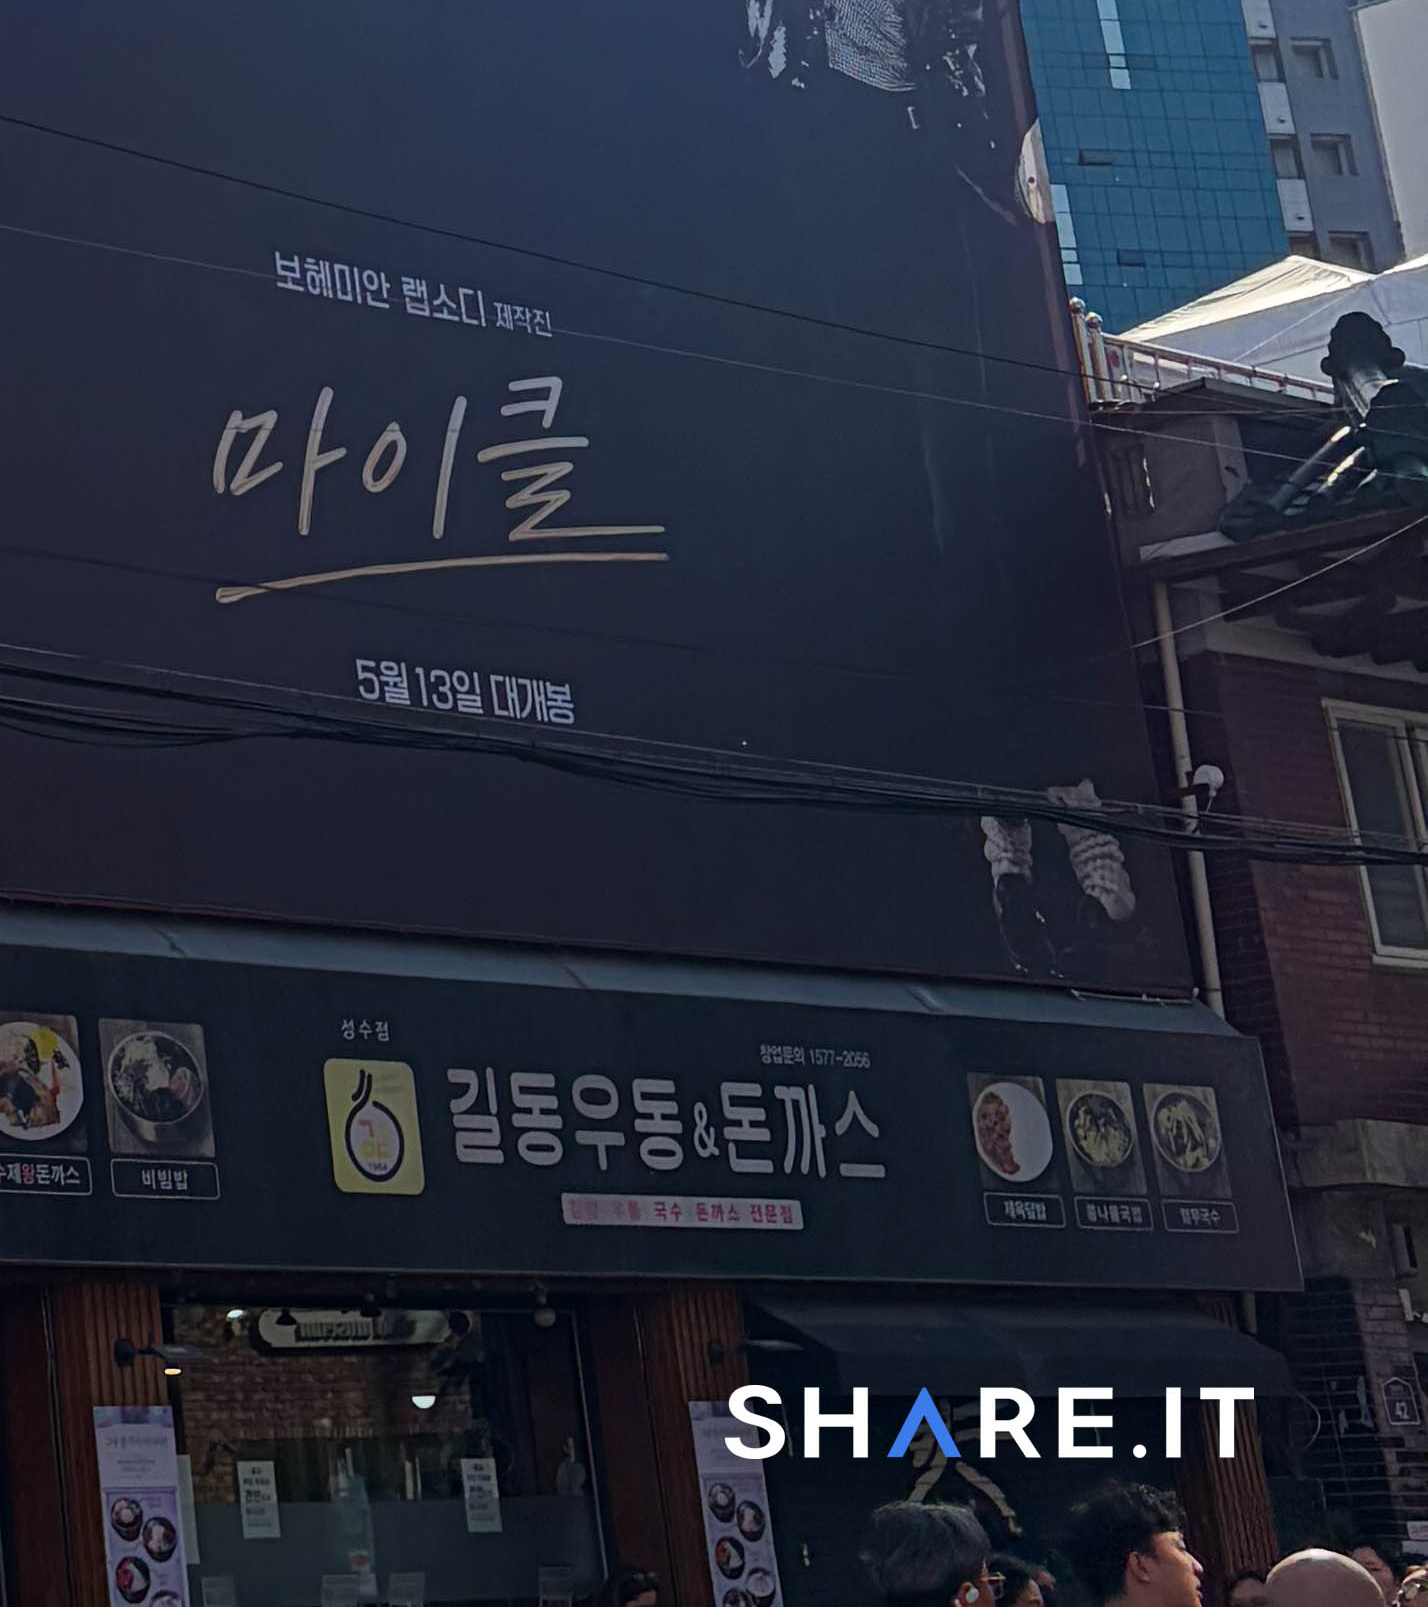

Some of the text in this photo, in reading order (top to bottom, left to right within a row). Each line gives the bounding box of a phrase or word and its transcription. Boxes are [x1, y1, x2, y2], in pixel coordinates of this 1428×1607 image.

[273, 250, 554, 338] 보헤미안 랩소디 제작진
[212, 375, 667, 543] 마이클
[355, 657, 577, 725] 5월 13일 대개봉
[339, 1017, 393, 1043] 성수점
[809, 1046, 873, 1070] 1577-2056
[445, 1066, 887, 1179] 길동우동&돈까스
[141, 1168, 190, 1191] 비빔밥
